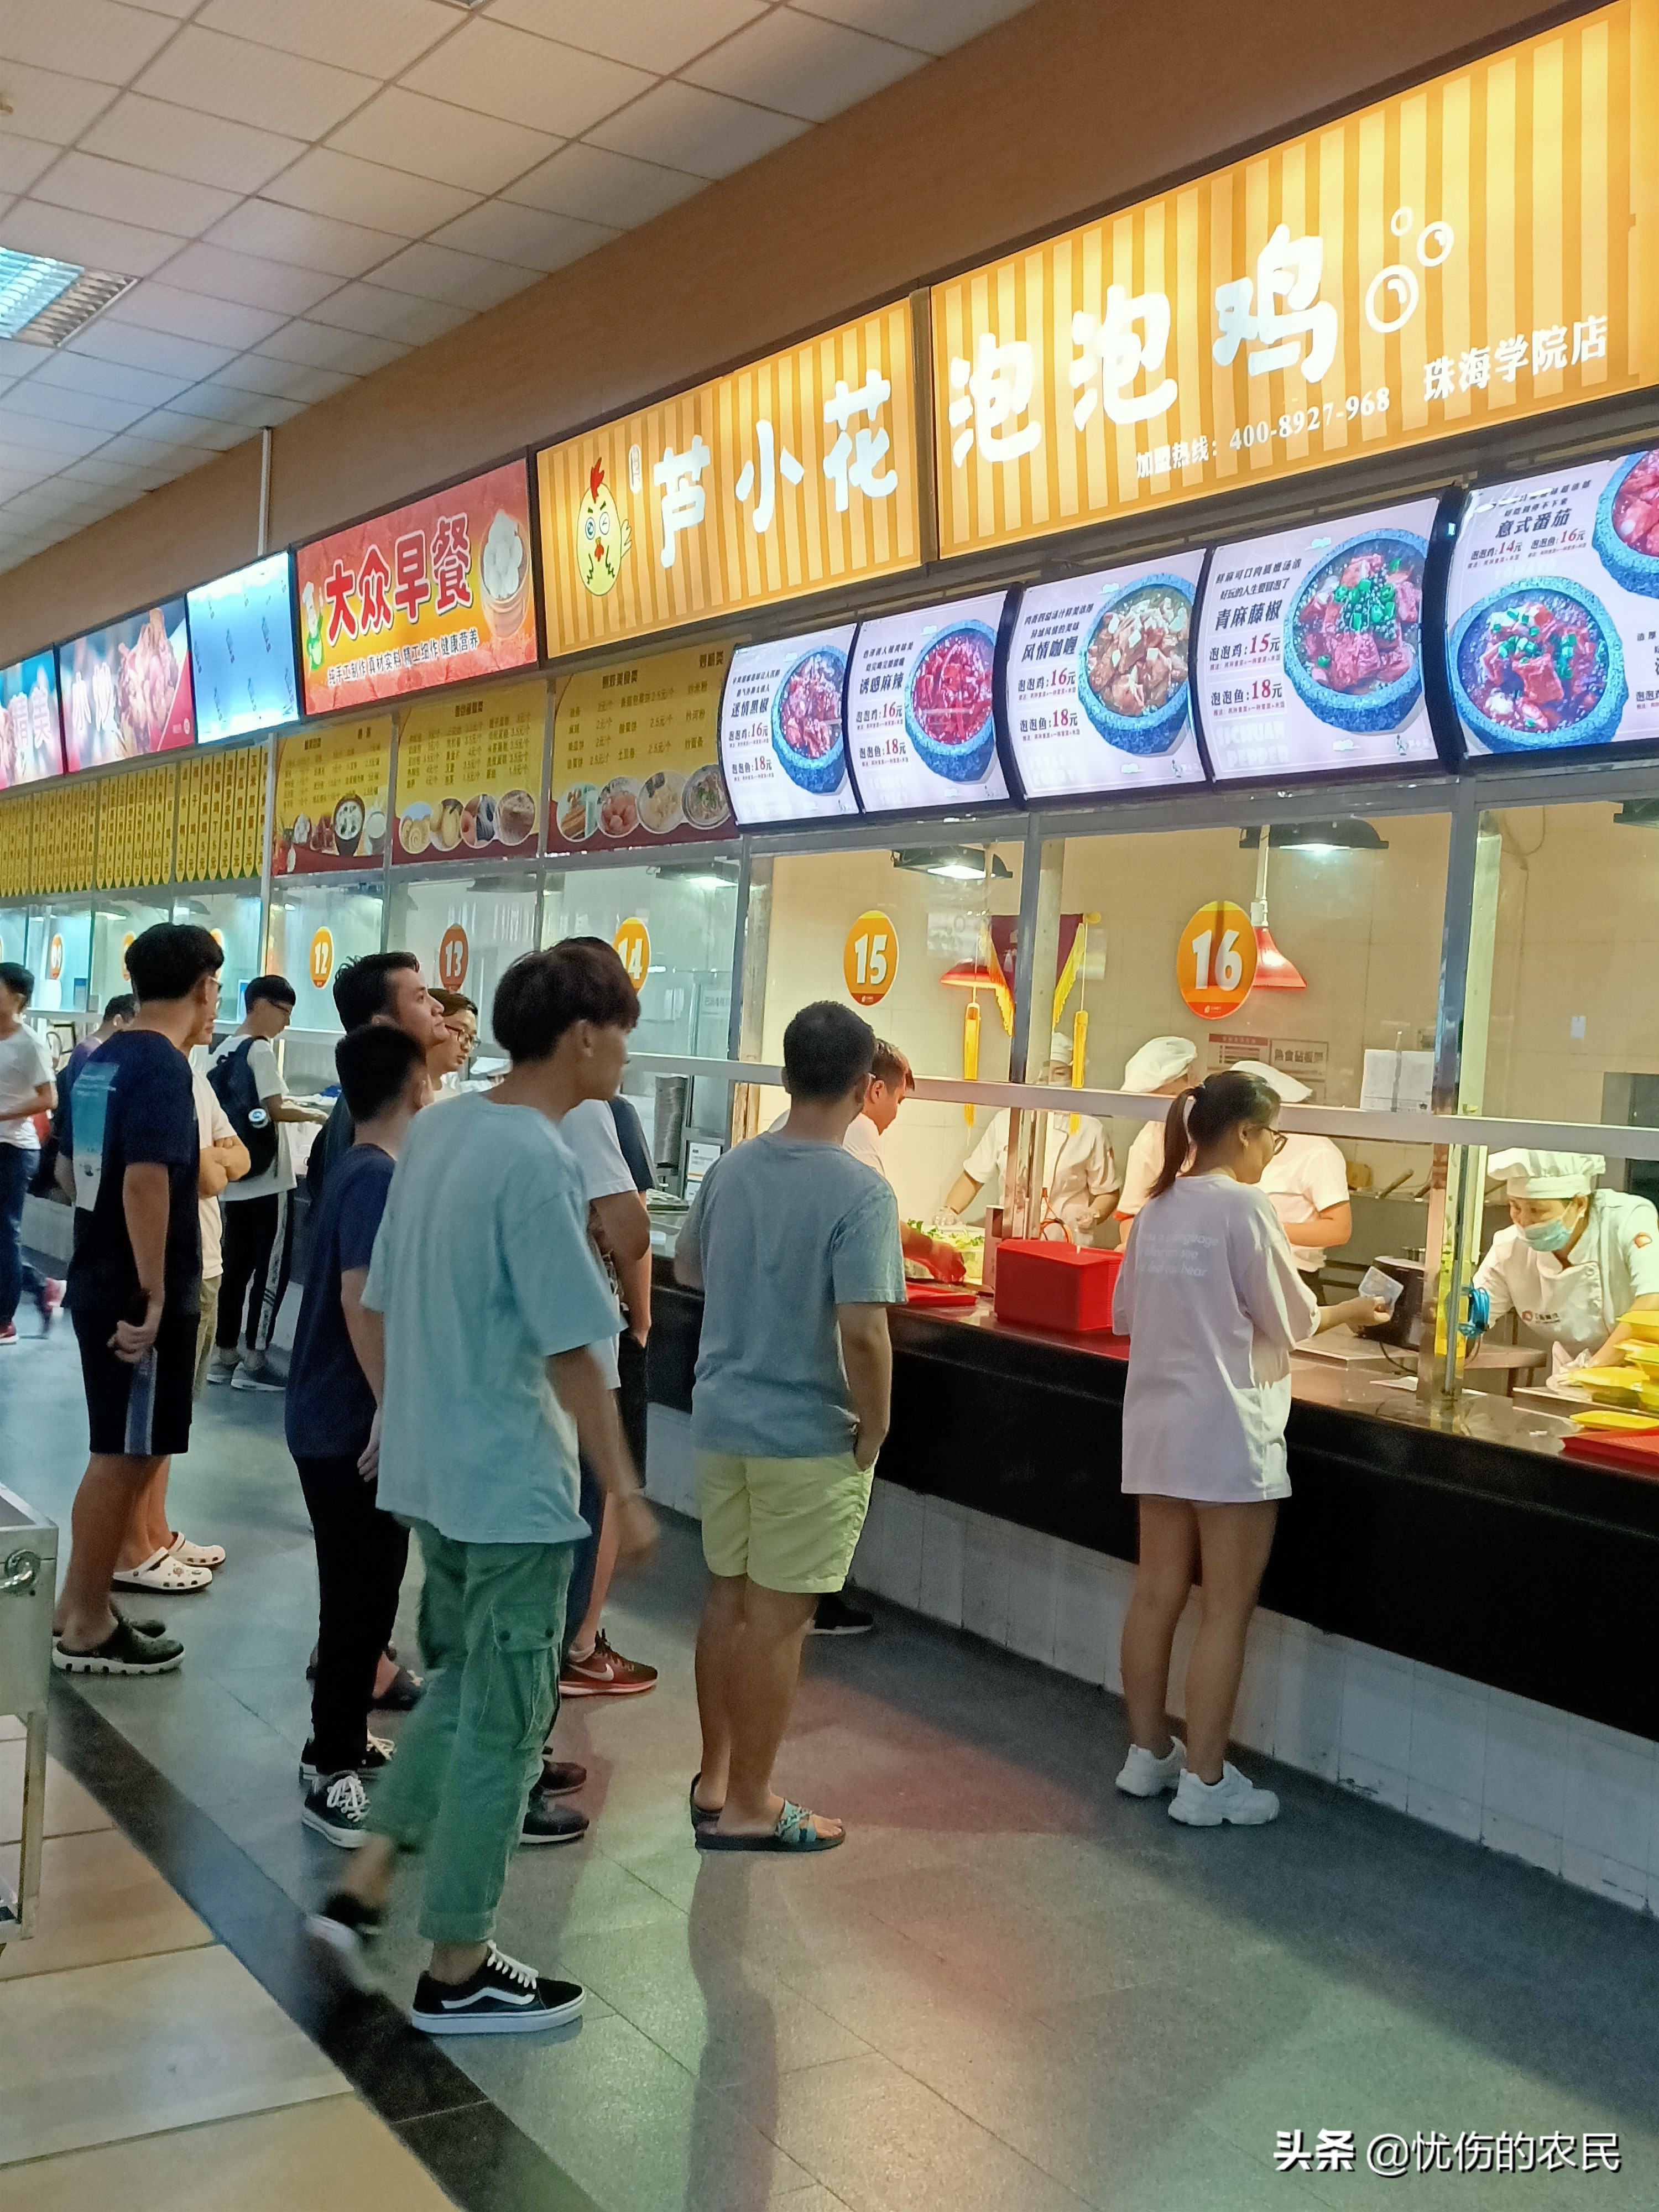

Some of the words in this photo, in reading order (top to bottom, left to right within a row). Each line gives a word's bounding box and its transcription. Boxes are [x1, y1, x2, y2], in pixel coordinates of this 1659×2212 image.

[948, 222, 1337, 468] 泡泡鸡
[1423, 314, 1608, 404] 珠海学院店
[653, 369, 898, 568] 芦小花
[1495, 508, 1572, 539] 意式番茄
[324, 512, 473, 646] 大众早餐
[1215, 599, 1283, 631] 青麻藤椒
[368, 649, 401, 675] 真材实料
[403, 639, 439, 665] 精工细作
[441, 629, 479, 655] 健康营养
[1021, 635, 1078, 662] 风情咖喱
[859, 672, 904, 695] 诱惑麻辣
[731, 697, 769, 718] 迷情黑椒
[314, 942, 330, 974] 12
[445, 940, 463, 977] 13
[618, 937, 643, 979] 14
[854, 932, 888, 985] 15
[1192, 929, 1243, 992] 16
